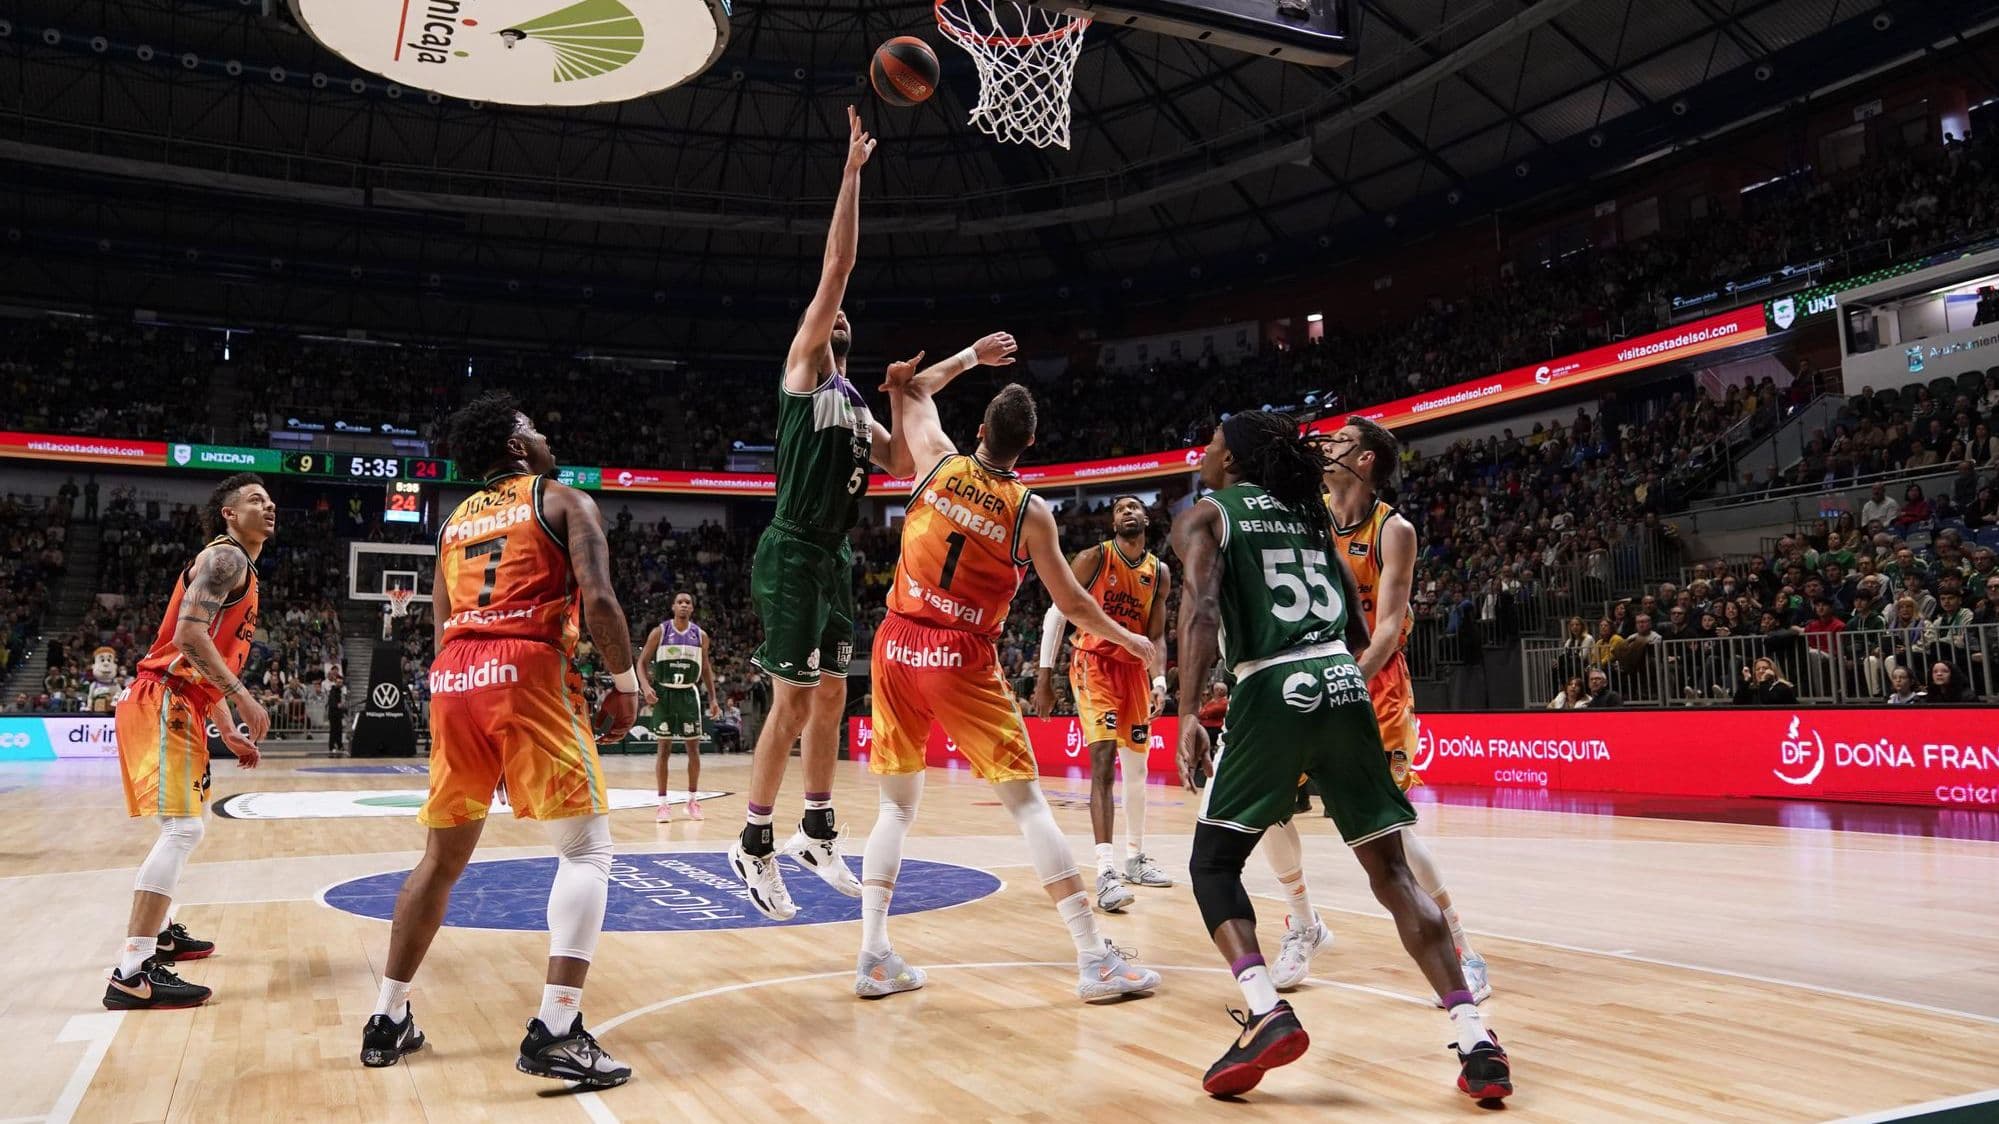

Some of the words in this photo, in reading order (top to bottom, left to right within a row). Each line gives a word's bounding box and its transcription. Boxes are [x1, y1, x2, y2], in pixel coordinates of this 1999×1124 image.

[407, 0, 478, 64] nicaja
[1617, 322, 1738, 362] visitacostadelsol.com
[1412, 383, 1502, 413] visitacostadelsol.com
[28, 441, 144, 456] visitacostadelsol.com
[201, 452, 255, 464] UNICAJA
[300, 455, 313, 472] 9
[350, 457, 398, 477] 5:35
[415, 461, 437, 477] 24
[1075, 461, 1158, 477] visitacostadelsol.com
[391, 494, 417, 511] 24
[460, 486, 517, 518] JONES
[945, 475, 1005, 515] CLAVER
[445, 503, 532, 544] PAMESA
[923, 488, 1007, 543] PAMESA
[464, 535, 508, 607] 7
[940, 530, 967, 590] 1
[1261, 548, 1342, 622] 55
[924, 589, 983, 625] isaval
[886, 640, 962, 667] Vitaldin
[1326, 679, 1354, 694] DEL
[1439, 735, 1485, 758] DOÑA
[1489, 738, 1611, 762] FRANCISQUITA
[1781, 741, 1813, 765] DF
[1835, 738, 1916, 768] DOÑA
[1494, 768, 1548, 786] catering
